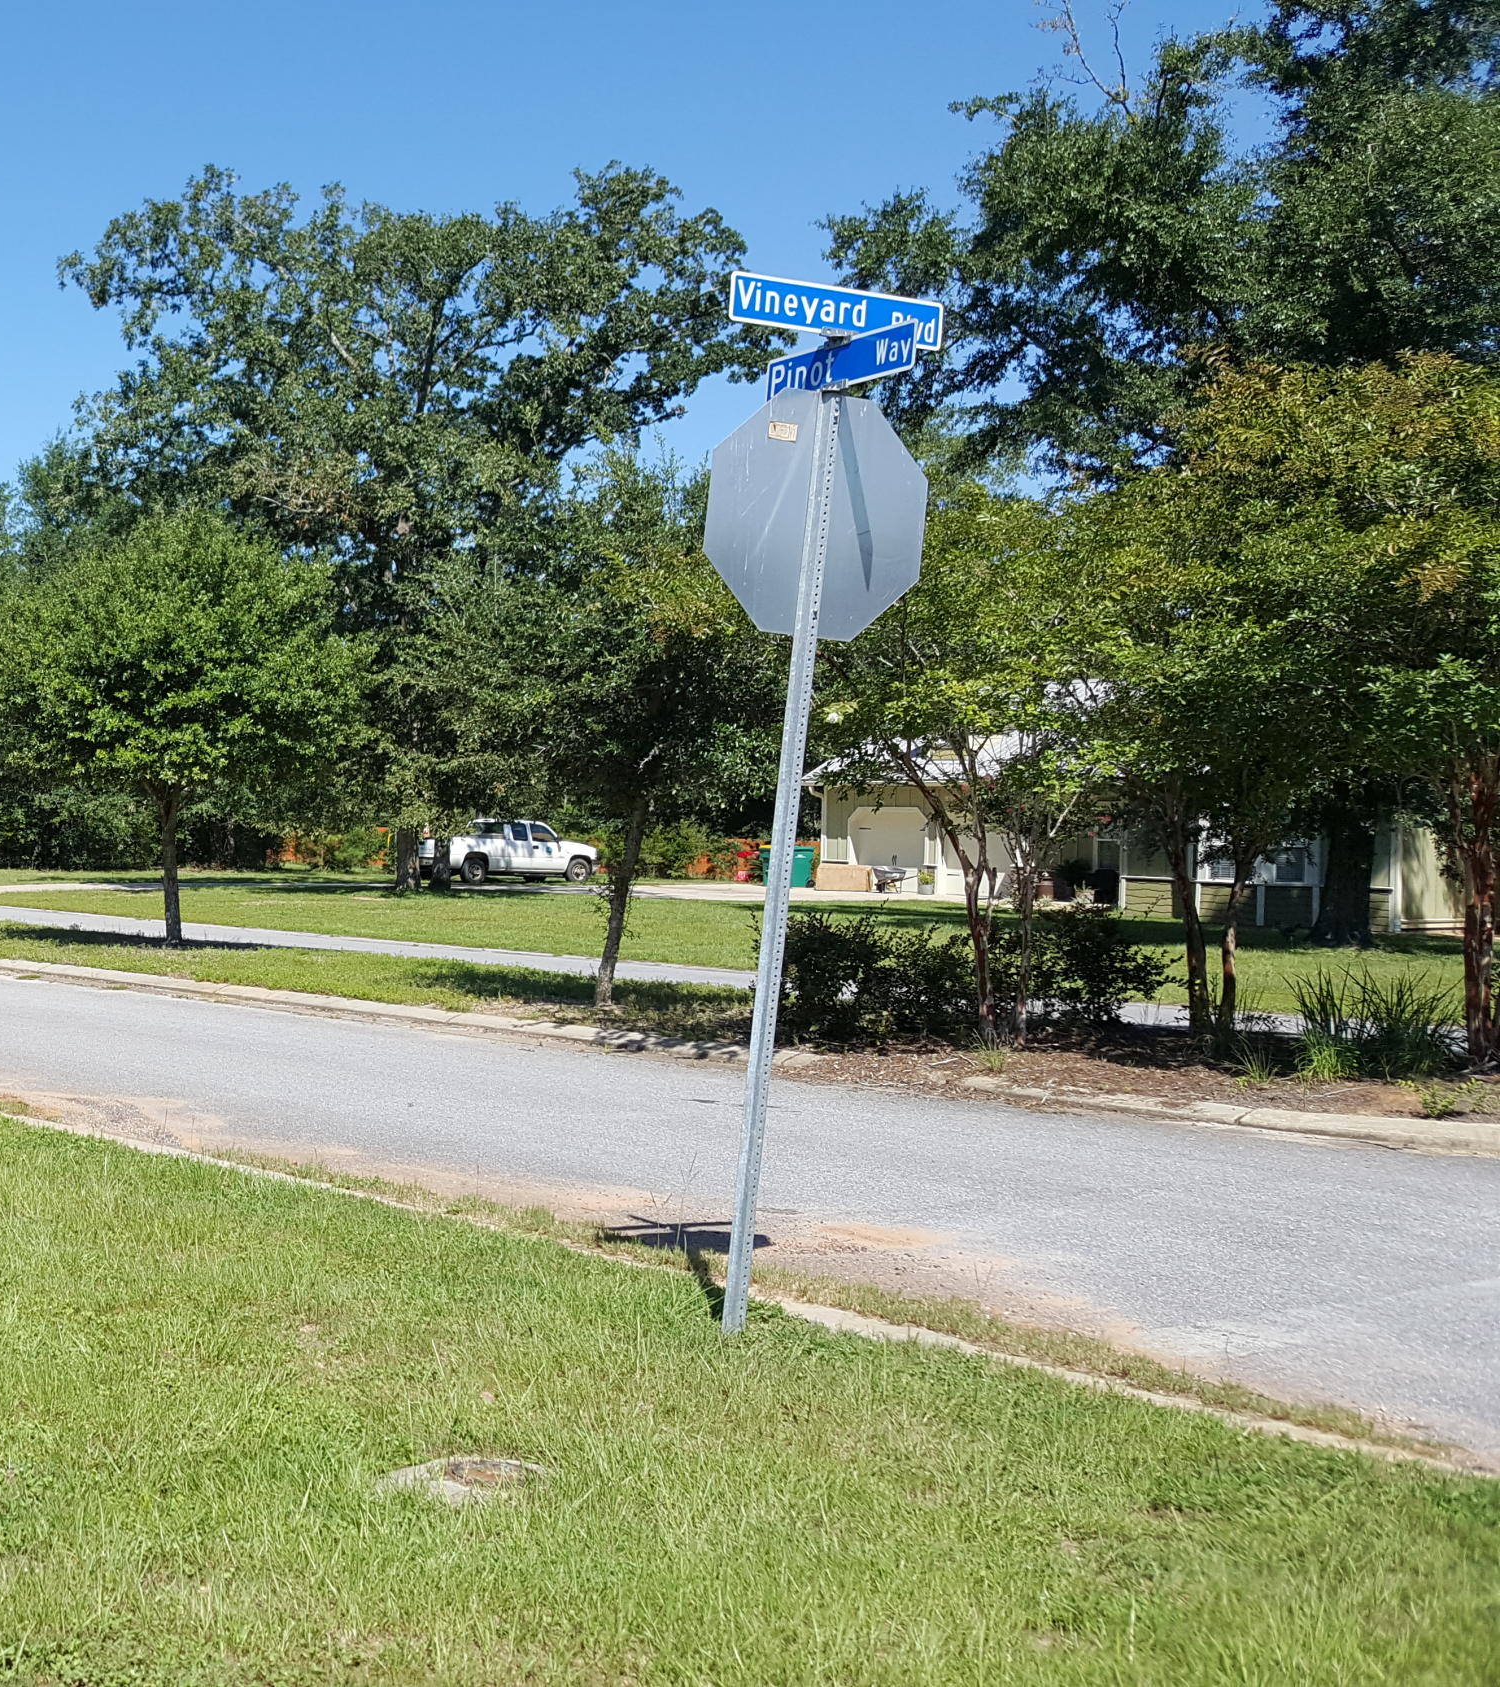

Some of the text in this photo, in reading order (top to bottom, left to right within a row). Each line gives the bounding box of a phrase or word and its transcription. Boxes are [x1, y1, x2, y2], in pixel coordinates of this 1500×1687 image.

[737, 279, 936, 343] Vineyard Bvd
[770, 337, 912, 398] Pinot Way
